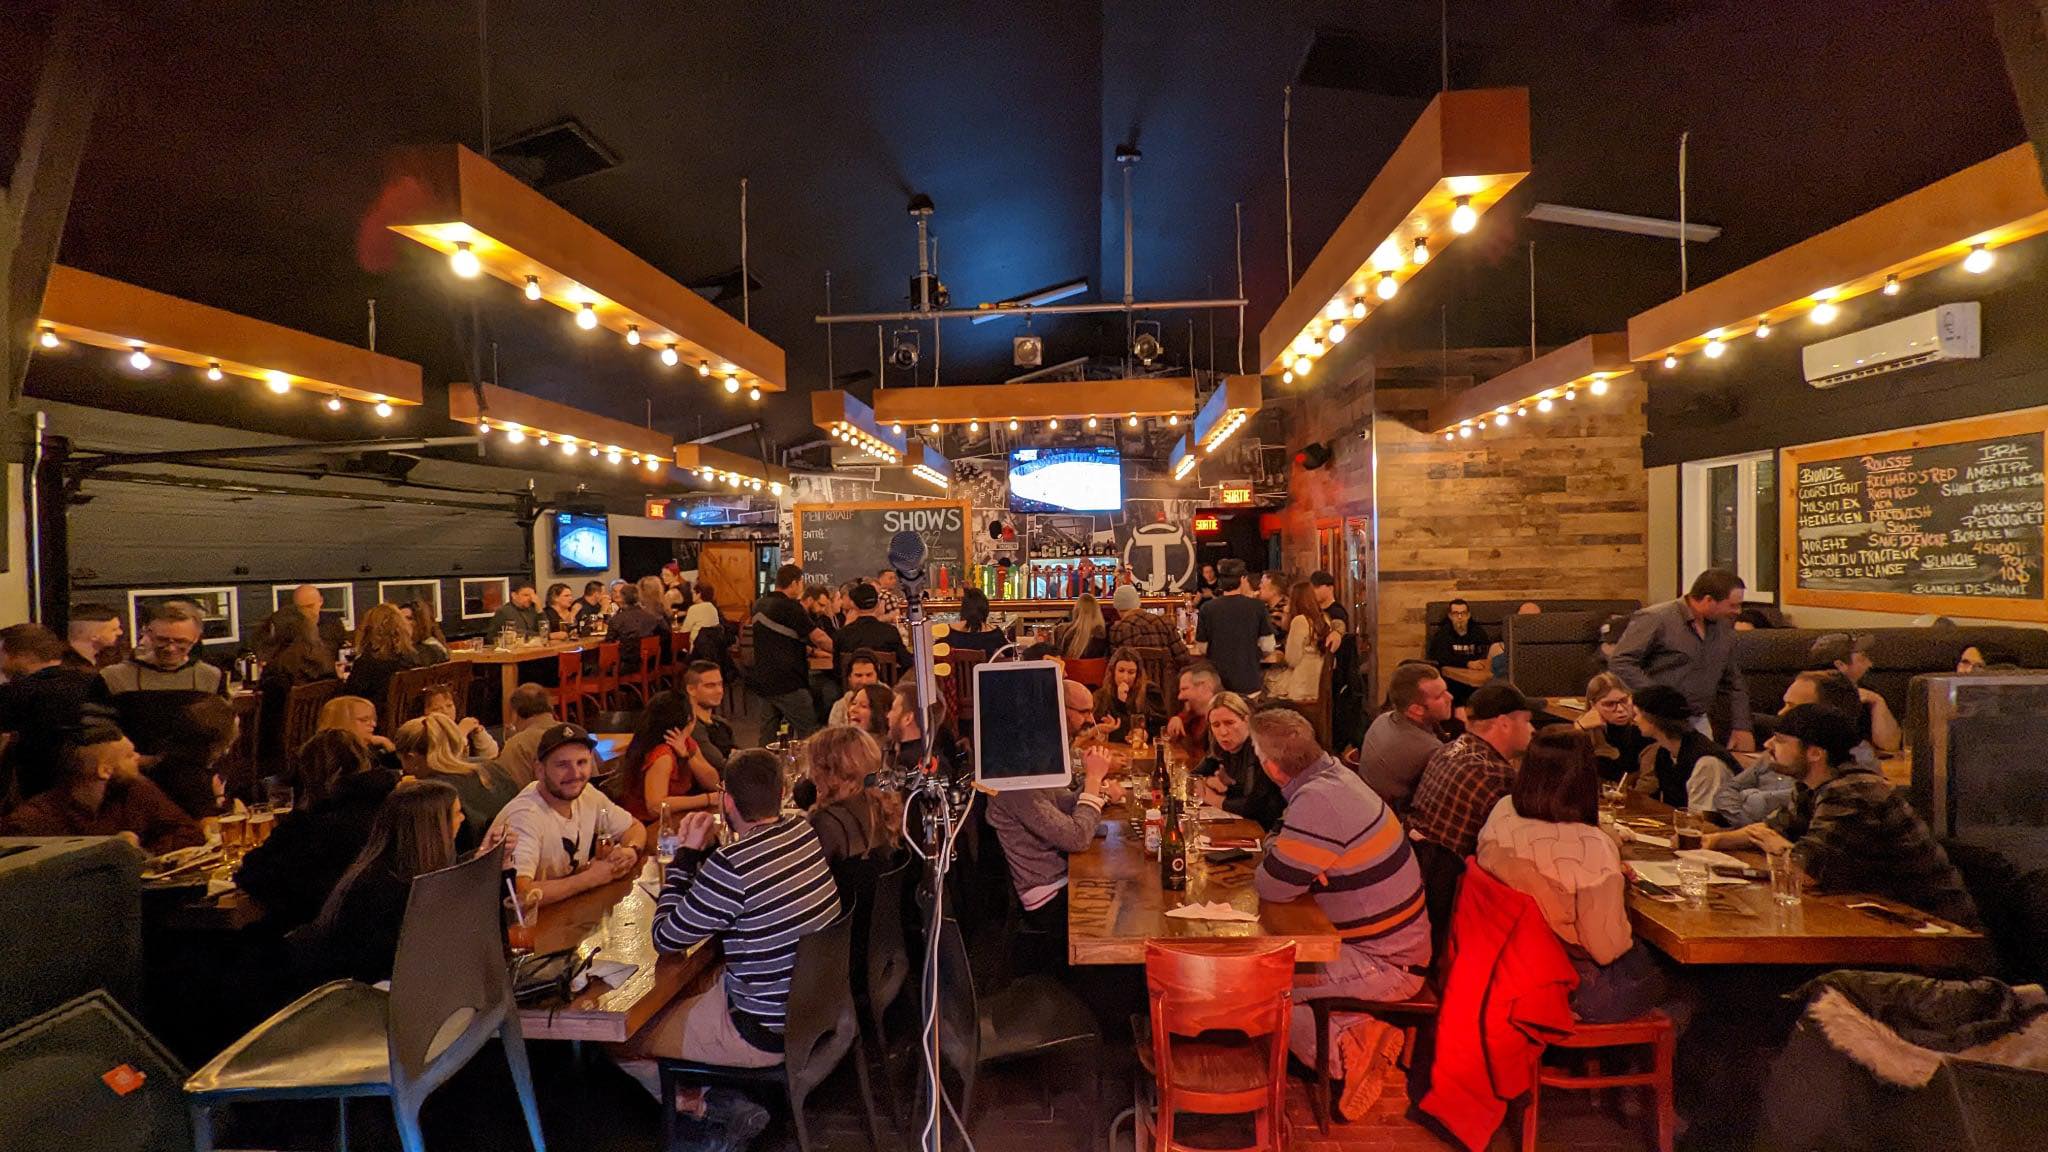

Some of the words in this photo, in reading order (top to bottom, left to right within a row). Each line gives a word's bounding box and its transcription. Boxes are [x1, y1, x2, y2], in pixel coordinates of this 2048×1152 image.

[1977, 444, 2029, 459] IPA
[1860, 455, 1913, 472] ROUSSE
[1800, 467, 1846, 483] BLONDE
[1929, 467, 1957, 483] RED
[1223, 489, 1251, 504] SORTIE
[1799, 486, 1827, 500] COORS
[1829, 481, 1863, 496] LIGHT
[1893, 486, 1918, 500] RED
[1842, 498, 1860, 509] EX
[1972, 502, 2043, 516] APOCALYPSO
[884, 509, 961, 532] SHOWS
[1195, 519, 1219, 531] SORTIE
[1799, 512, 1863, 526] HEINEKEN
[1960, 512, 2045, 528] PERROQUET
[1802, 537, 1848, 553] MORETTI
[1799, 552, 1839, 567] SAISON
[1840, 552, 1856, 566] DU
[1858, 547, 1920, 565] TRACTEUR
[1922, 553, 1977, 568] BLANCHE
[1845, 567, 1863, 577] DE
[1912, 583, 1963, 594] BLANCHE
[1964, 583, 1982, 595] DE
